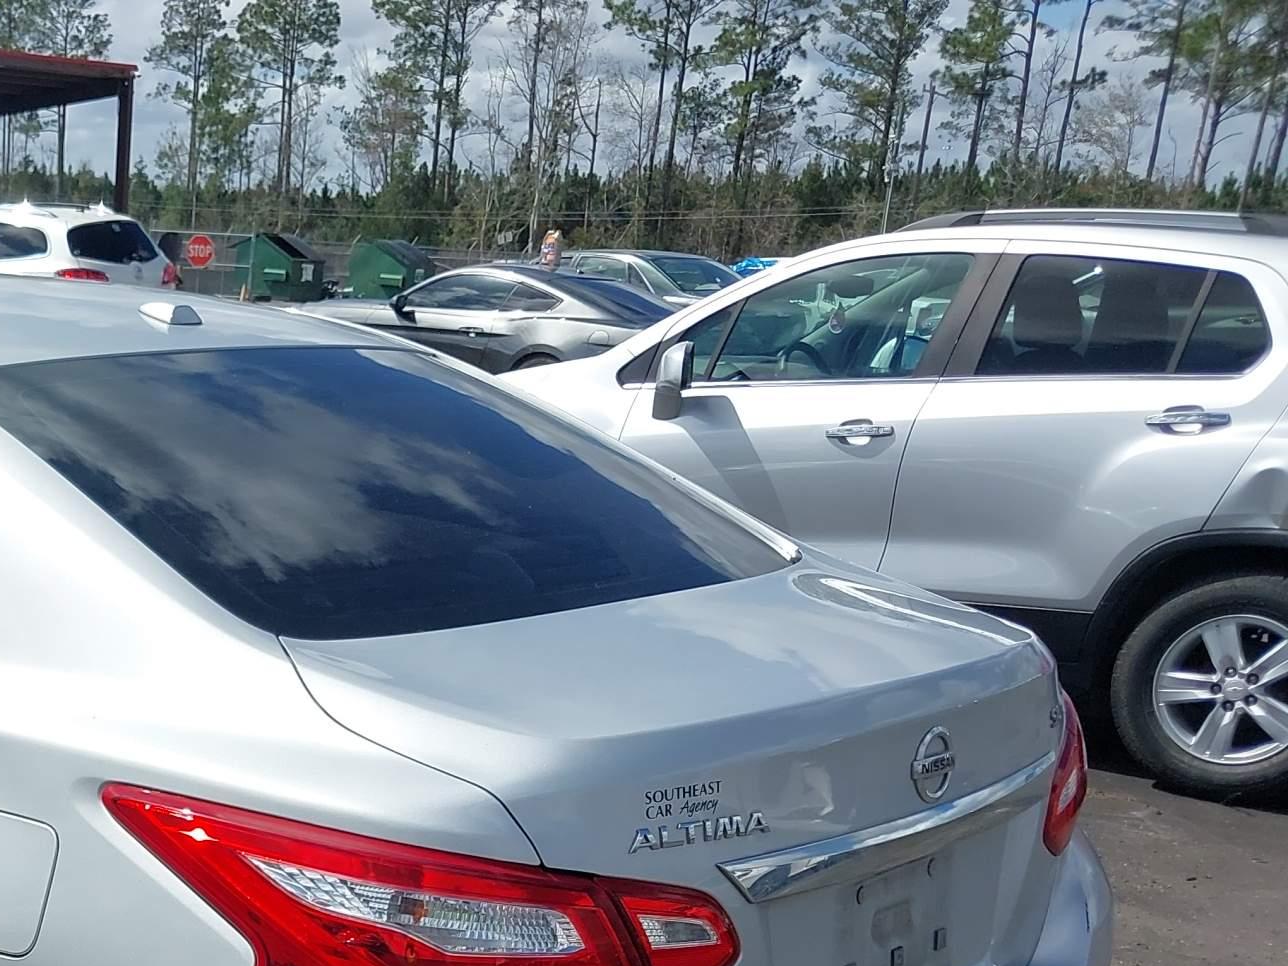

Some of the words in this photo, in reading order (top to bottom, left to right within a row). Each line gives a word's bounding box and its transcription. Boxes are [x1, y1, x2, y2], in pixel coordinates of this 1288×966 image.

[188, 245, 212, 257] STOP
[921, 755, 956, 775] NISSAN
[645, 780, 722, 804] SOUTHEAST
[646, 804, 673, 820] CAR
[679, 798, 719, 817] Agency
[628, 811, 771, 854] ALTIMA
